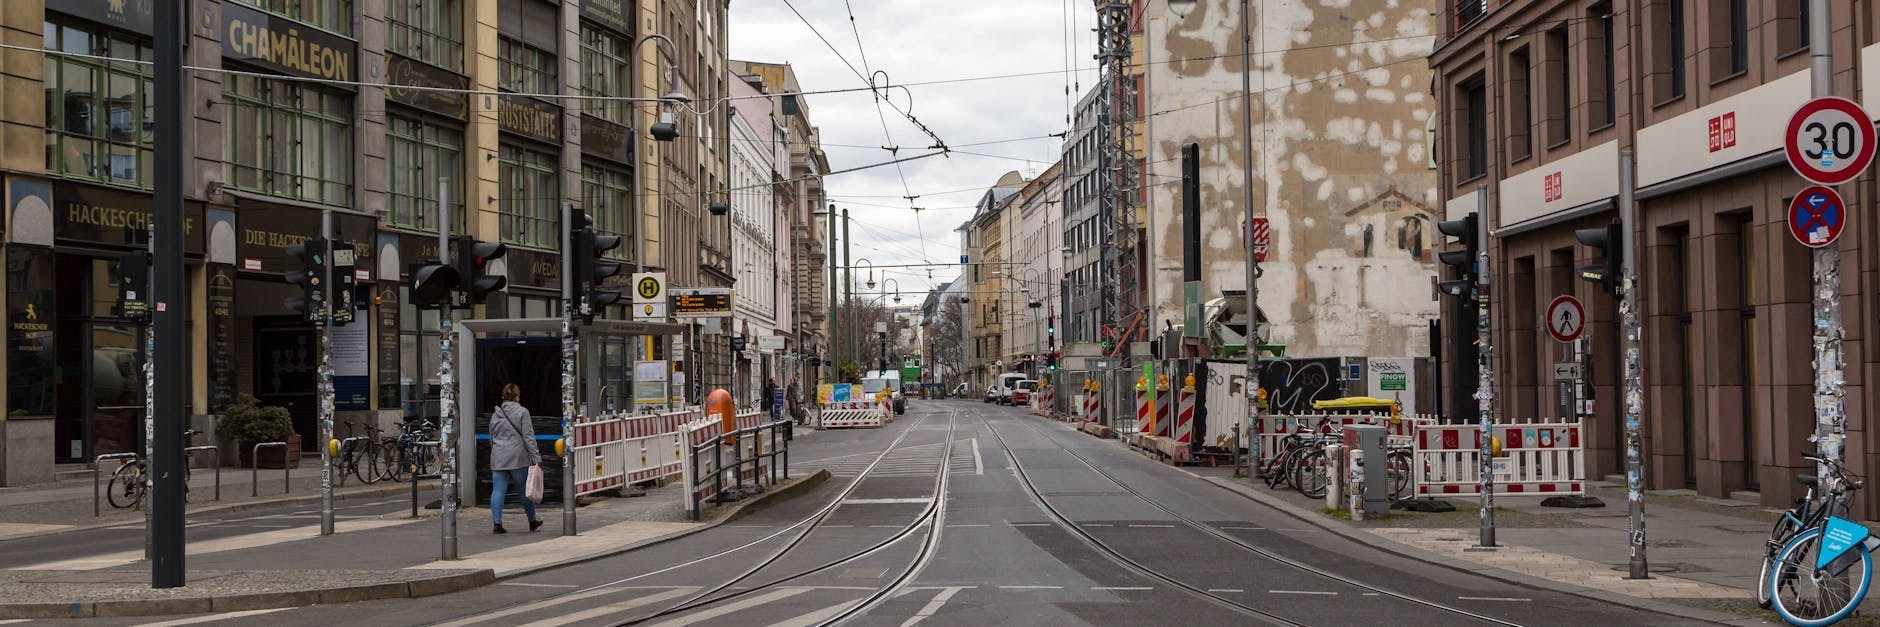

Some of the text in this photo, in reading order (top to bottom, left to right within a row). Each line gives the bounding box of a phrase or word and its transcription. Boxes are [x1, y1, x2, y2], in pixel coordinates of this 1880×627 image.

[498, 95, 556, 139] RÖSTSTÄTTE
[1805, 121, 1855, 160] 30
[68, 203, 154, 231] HACKESCHE
[245, 229, 266, 246] DIE
[1380, 373, 1406, 381] FINOW
